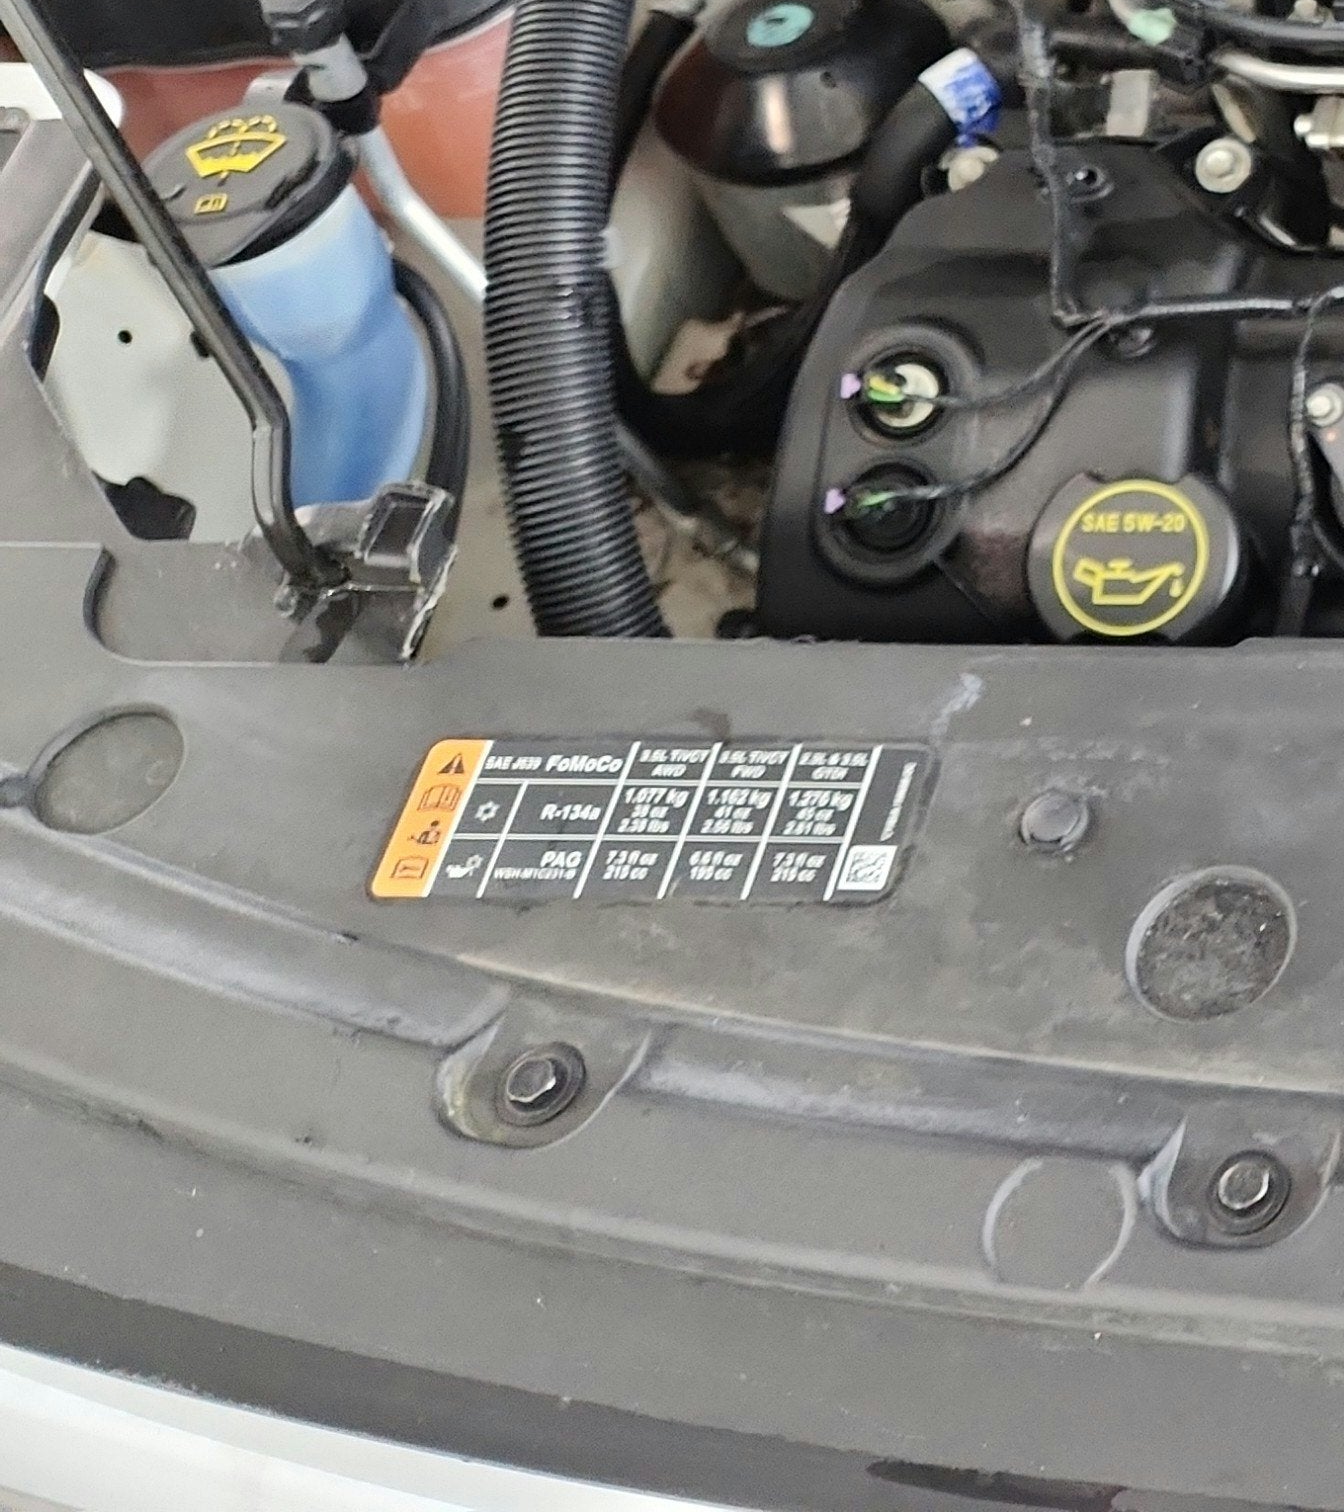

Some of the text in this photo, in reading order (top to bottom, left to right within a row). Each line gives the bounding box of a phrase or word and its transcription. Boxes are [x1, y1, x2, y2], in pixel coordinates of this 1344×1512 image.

[1081, 512, 1187, 533] SAE 5W-20
[484, 756, 511, 771] SAE
[545, 754, 624, 774] FoMoCo
[651, 764, 687, 778] AWD
[730, 764, 766, 779] FWD
[665, 788, 690, 808] kg
[750, 789, 773, 809] kg
[829, 790, 855, 811] kg
[539, 803, 603, 821] R-134a
[540, 850, 584, 869] PAG
